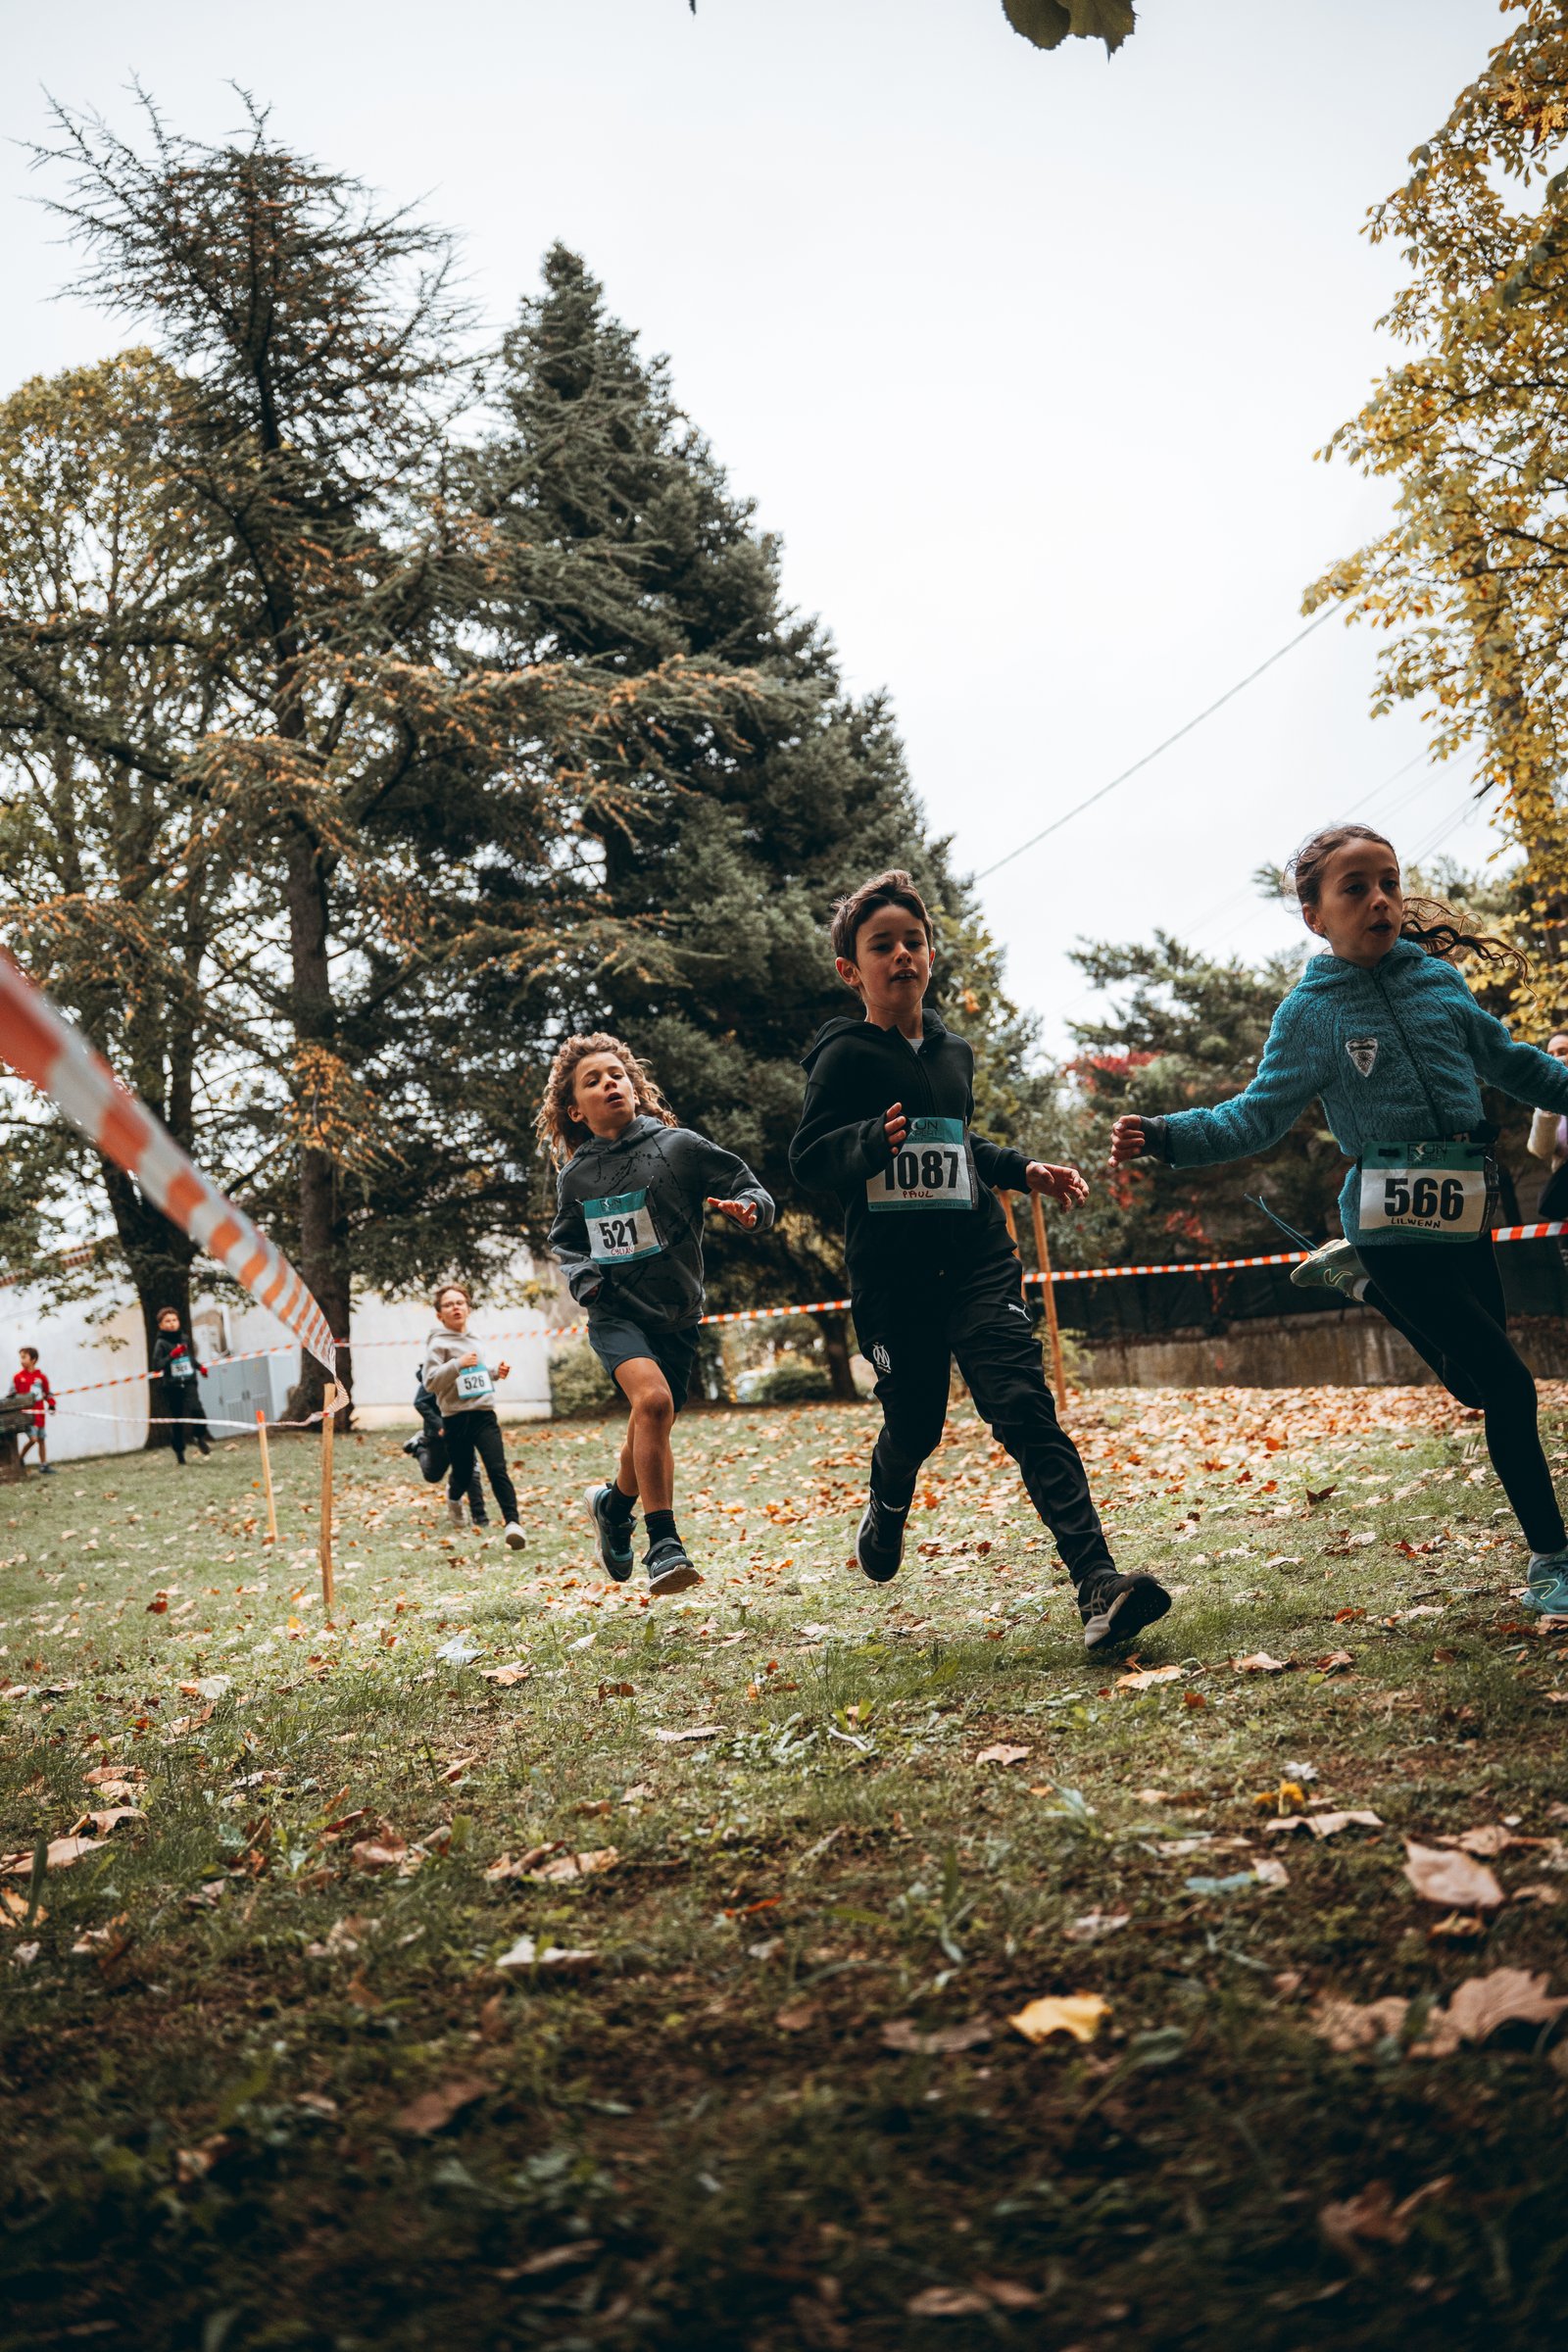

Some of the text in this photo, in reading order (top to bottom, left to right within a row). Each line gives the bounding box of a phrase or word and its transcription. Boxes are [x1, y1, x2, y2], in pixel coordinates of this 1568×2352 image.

[885, 1151, 958, 1190] 1087
[903, 1190, 933, 1199] PAUL
[1385, 1178, 1464, 1221] 566
[599, 1218, 638, 1249] 521
[1391, 1216, 1441, 1229] LILWENN
[464, 1375, 485, 1391] 526
